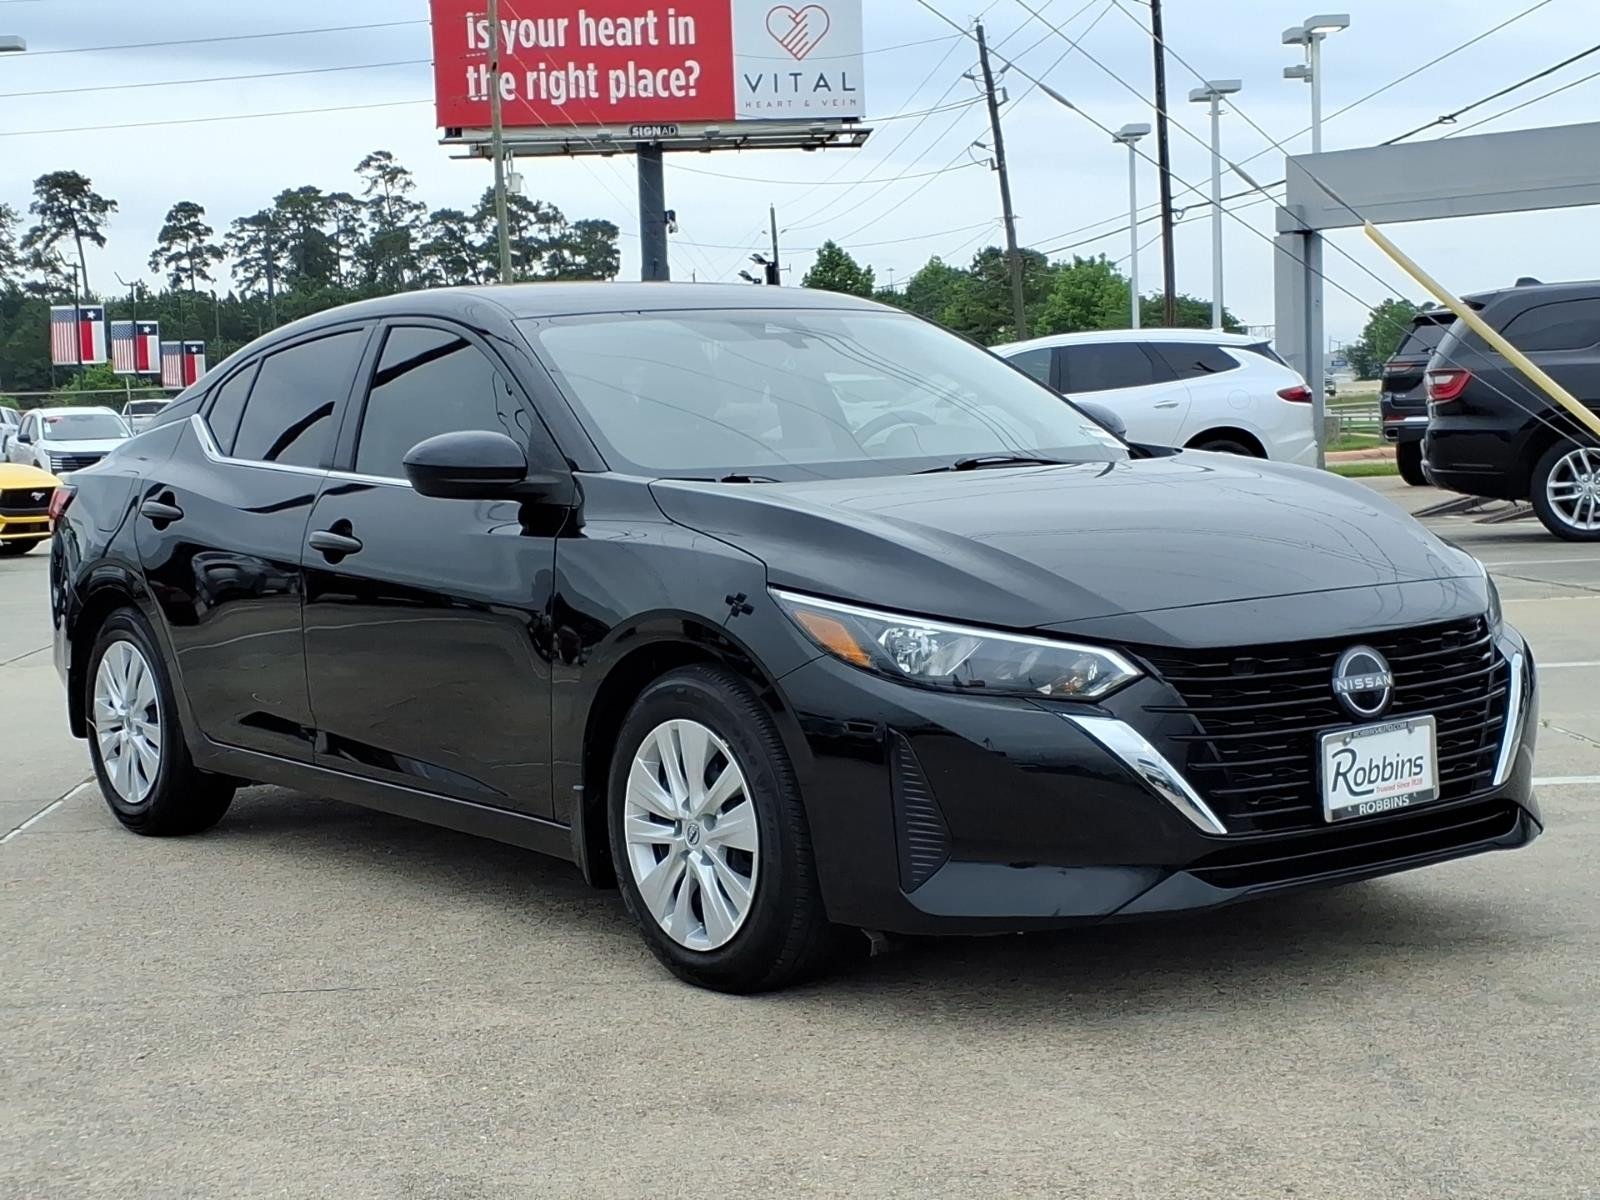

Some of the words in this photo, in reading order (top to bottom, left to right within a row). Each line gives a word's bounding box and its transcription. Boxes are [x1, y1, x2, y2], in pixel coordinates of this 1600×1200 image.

[466, 12, 490, 49] is
[501, 18, 568, 54] your
[578, 9, 659, 47] heart
[668, 8, 695, 45] in
[526, 62, 599, 105] right
[609, 60, 701, 104] place?
[744, 71, 856, 94] VITAL
[745, 100, 793, 109] HEART
[804, 100, 810, 108] &
[822, 98, 857, 107] VEIN
[1336, 674, 1392, 691] NISSAN
[1331, 748, 1424, 797] Robbins
[1359, 795, 1410, 815] ROBBINS
